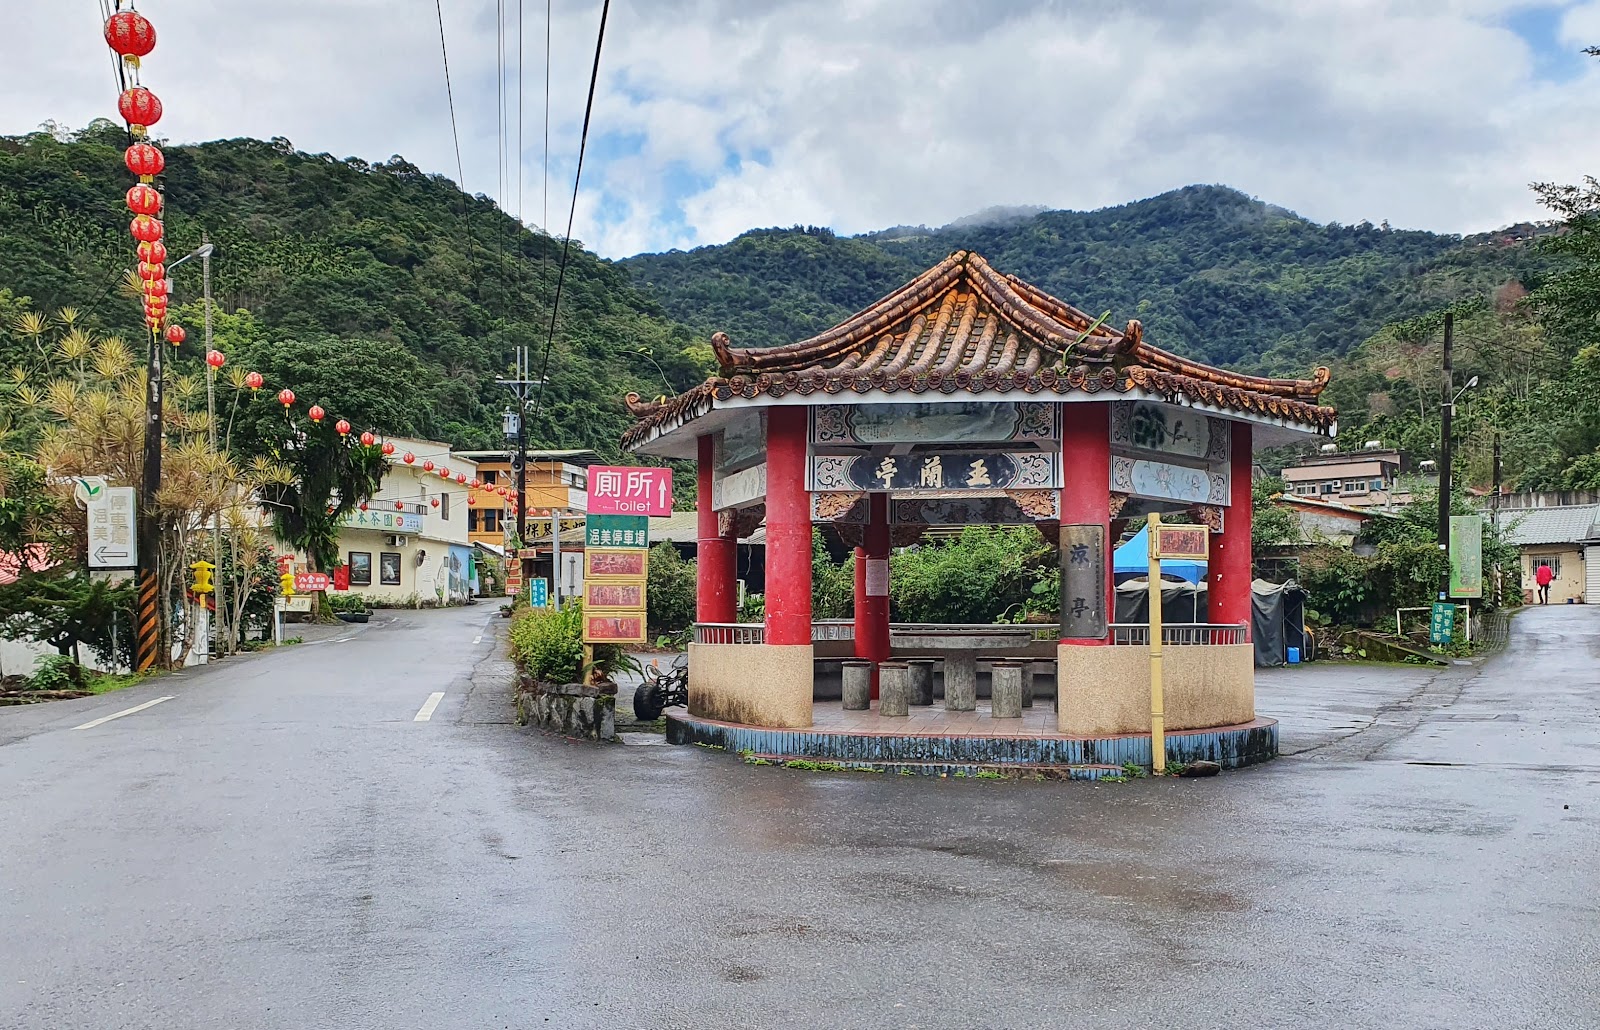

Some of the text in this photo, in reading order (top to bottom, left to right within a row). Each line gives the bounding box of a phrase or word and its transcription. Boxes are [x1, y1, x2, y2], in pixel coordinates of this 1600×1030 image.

[594, 470, 653, 499] 廁所
[614, 500, 651, 512] Toilet
[93, 508, 108, 541] 浥美
[589, 529, 646, 546] 浥美停車場
